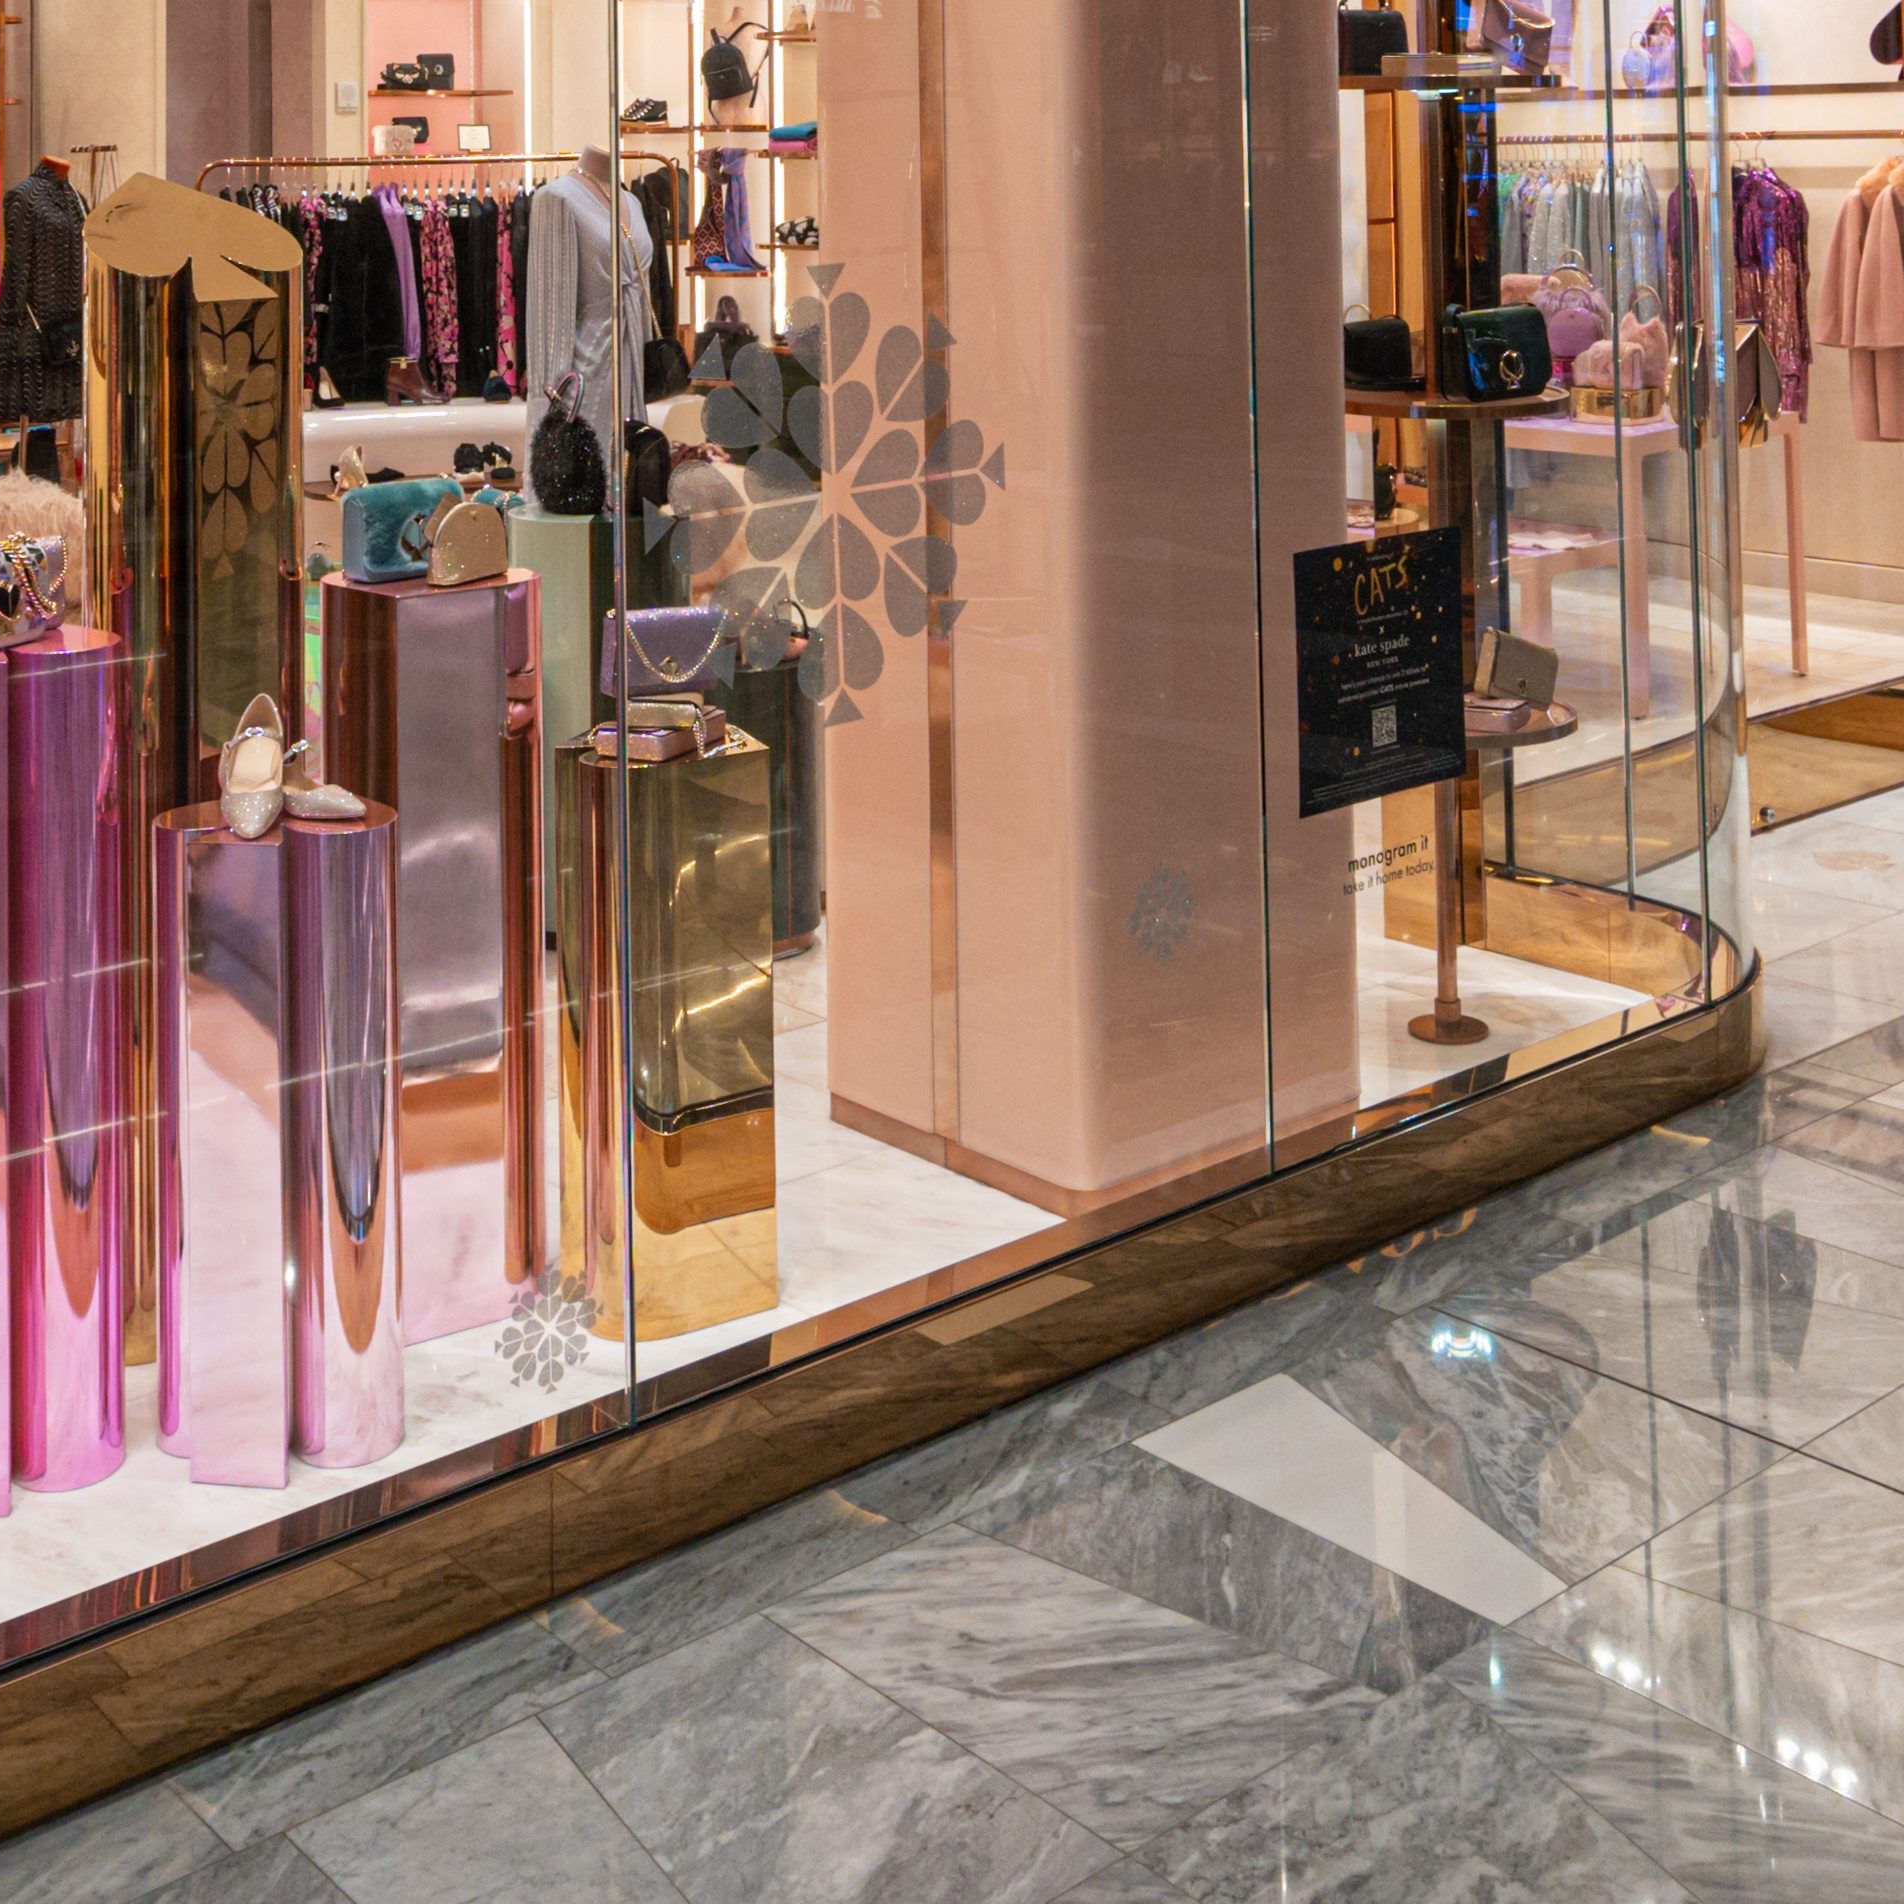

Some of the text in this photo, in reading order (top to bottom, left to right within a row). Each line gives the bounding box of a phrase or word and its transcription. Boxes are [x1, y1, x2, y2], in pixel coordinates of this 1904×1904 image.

[1353, 554, 1409, 616] CATS
[1354, 633, 1410, 658] kate spade
[1348, 835, 1428, 873] monogram it
[1343, 881, 1365, 897] take
[1368, 876, 1374, 889] it
[1376, 872, 1403, 886] home
